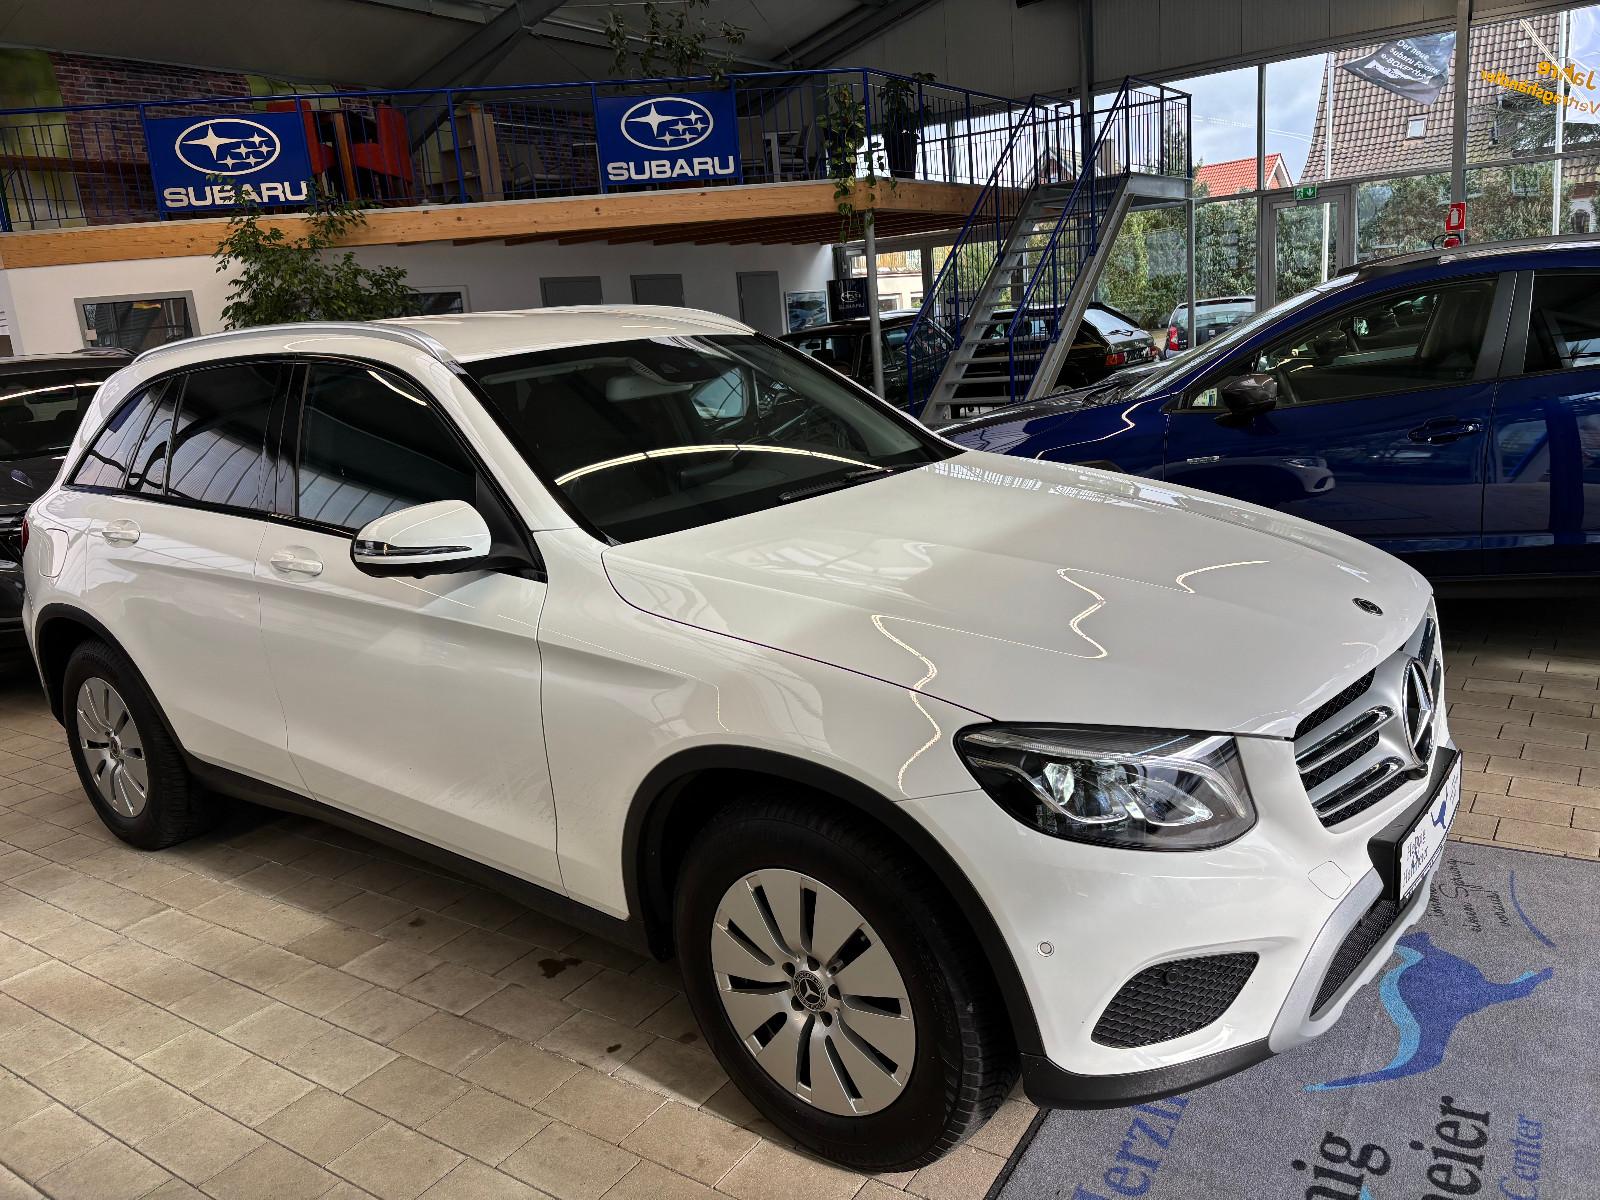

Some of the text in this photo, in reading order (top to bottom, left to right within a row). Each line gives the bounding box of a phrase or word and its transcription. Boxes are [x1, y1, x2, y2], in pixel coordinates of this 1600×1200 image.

[1389, 47, 1415, 65] Subaru
[1396, 39, 1430, 60] Der neue
[607, 155, 735, 181] SUBARU
[163, 181, 308, 208] SUBARU
[1409, 1096, 1490, 1200] eier
